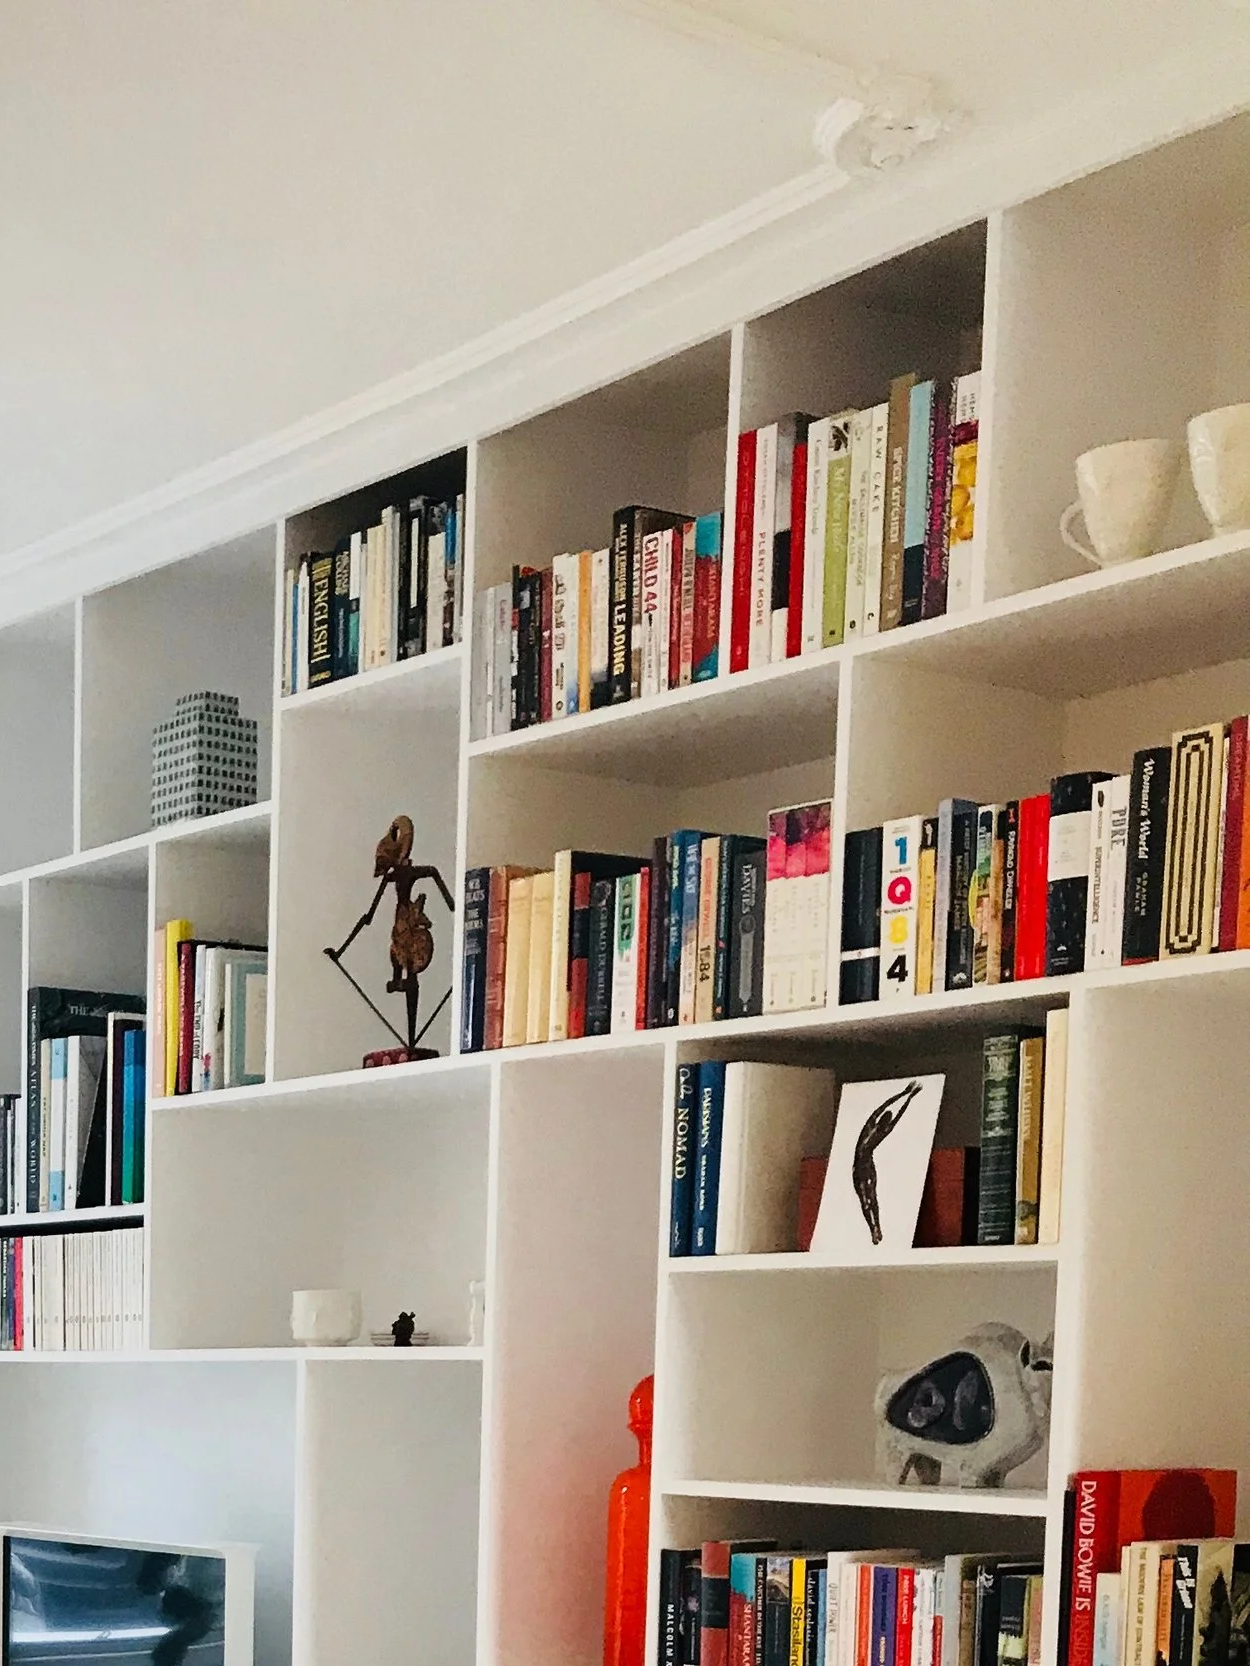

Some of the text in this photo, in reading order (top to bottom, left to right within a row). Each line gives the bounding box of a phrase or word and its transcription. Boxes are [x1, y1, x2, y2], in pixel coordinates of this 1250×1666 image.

[871, 425, 884, 513] RAW CAKE
[890, 446, 903, 543] SPICE KITCHEN
[618, 523, 629, 547] ALEX
[617, 549, 627, 601] FERGUSON
[643, 536, 660, 614] CHILD 44
[755, 531, 767, 627] PLENTY MORE
[312, 580, 329, 656] ENGLISH
[612, 604, 627, 675] LEADING
[1137, 758, 1156, 860] Woman's World
[740, 864, 753, 915] DAVIES
[1004, 830, 1016, 910] RAYMOND CHANDLER
[1091, 846, 1102, 924] SUPERINTELLIGENCE
[1139, 871, 1149, 916] GRAHAM
[29, 1070, 38, 1184] ATLAS WORLD
[674, 1107, 690, 1179] NOMAD
[701, 1087, 713, 1148] PARISIANS
[1079, 1480, 1097, 1535] DAVID
[1077, 1537, 1094, 1594] BOWIE
[1136, 1562, 1146, 1595] MODERN
[1138, 1547, 1148, 1561] THE
[806, 1576, 816, 1605] david
[1074, 1596, 1091, 1611] IS
[1135, 1596, 1145, 1614] LAW
[665, 1604, 675, 1657] MALCOLM
[827, 1608, 838, 1634] POWER
[1133, 1627, 1144, 1666] CONTRACT
